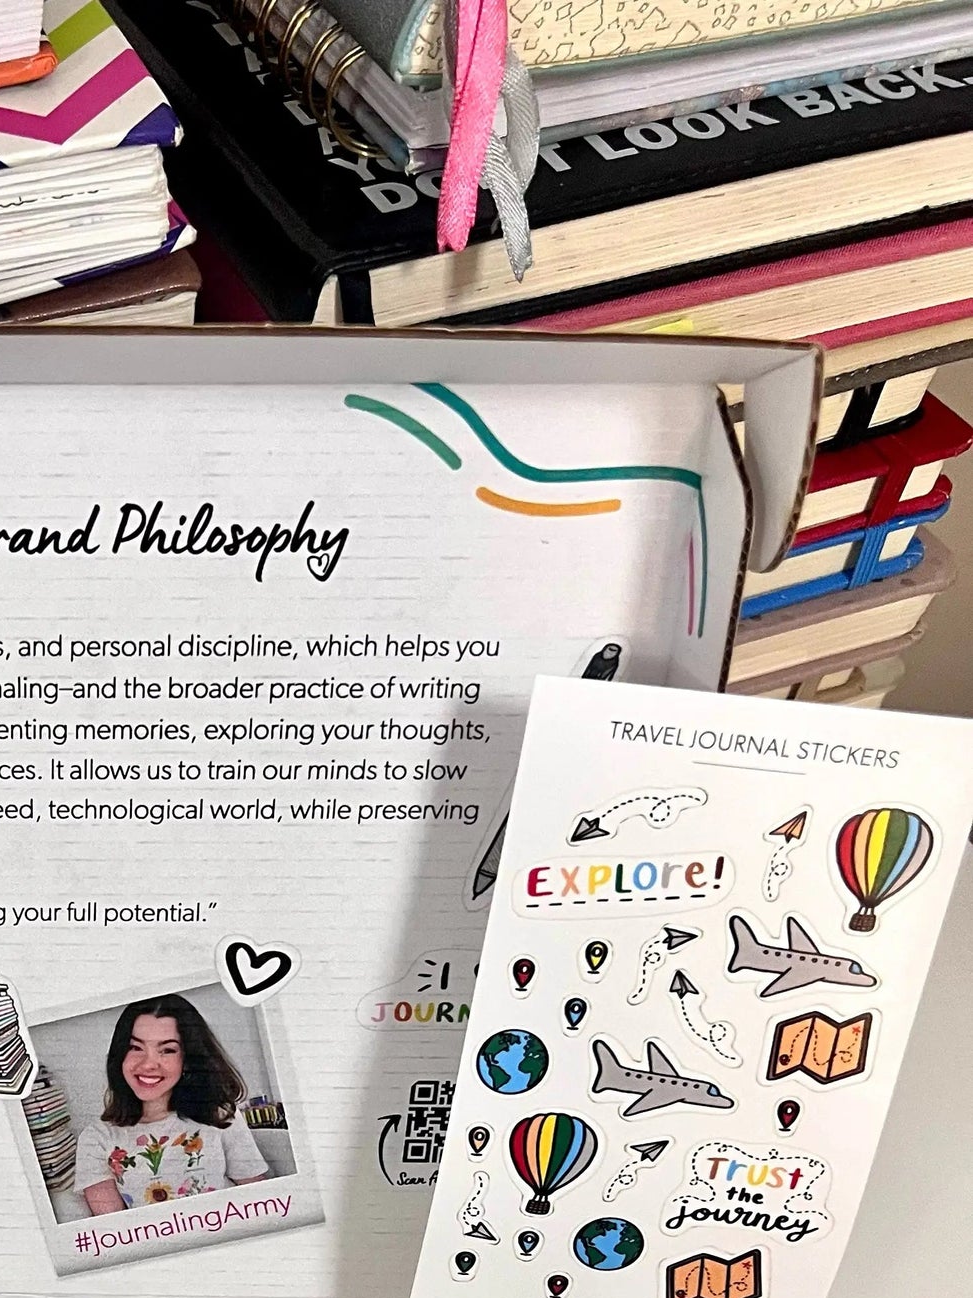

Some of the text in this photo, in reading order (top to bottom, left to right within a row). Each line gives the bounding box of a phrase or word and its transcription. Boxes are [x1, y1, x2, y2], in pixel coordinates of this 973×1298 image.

[585, 101, 780, 160] LOOK
[111, 499, 350, 583] Philosophy
[18, 634, 62, 657] and
[70, 633, 171, 663] personal
[178, 633, 298, 663] discipline,
[306, 633, 378, 657] which
[385, 633, 450, 662] helps
[455, 640, 500, 663] you
[123, 676, 162, 699] the
[168, 676, 264, 699] broader
[269, 678, 365, 704] practice
[370, 675, 399, 699] of
[398, 676, 481, 705] writing
[75, 718, 196, 744] memories,
[204, 717, 315, 746] exploring
[321, 724, 375, 746] your
[380, 717, 491, 746] thoughts,
[610, 720, 900, 769] TRAVEL JOURNAL STICKERS
[51, 758, 64, 780] It
[69, 758, 141, 780] allows
[147, 764, 172, 780] us
[178, 760, 201, 780] to
[207, 759, 256, 780] train
[262, 764, 303, 780] our
[307, 758, 377, 780] minds
[384, 760, 407, 780] to
[412, 758, 468, 781] slow
[48, 798, 204, 825] technological
[209, 798, 283, 823] world,
[290, 798, 352, 820] while
[357, 798, 480, 826] preserving
[12, 907, 62, 927] your
[66, 901, 97, 922] full
[725, 1186, 764, 1205] the
[74, 1195, 292, 1257] #JournalingArmy
[665, 1197, 820, 1243] journey
